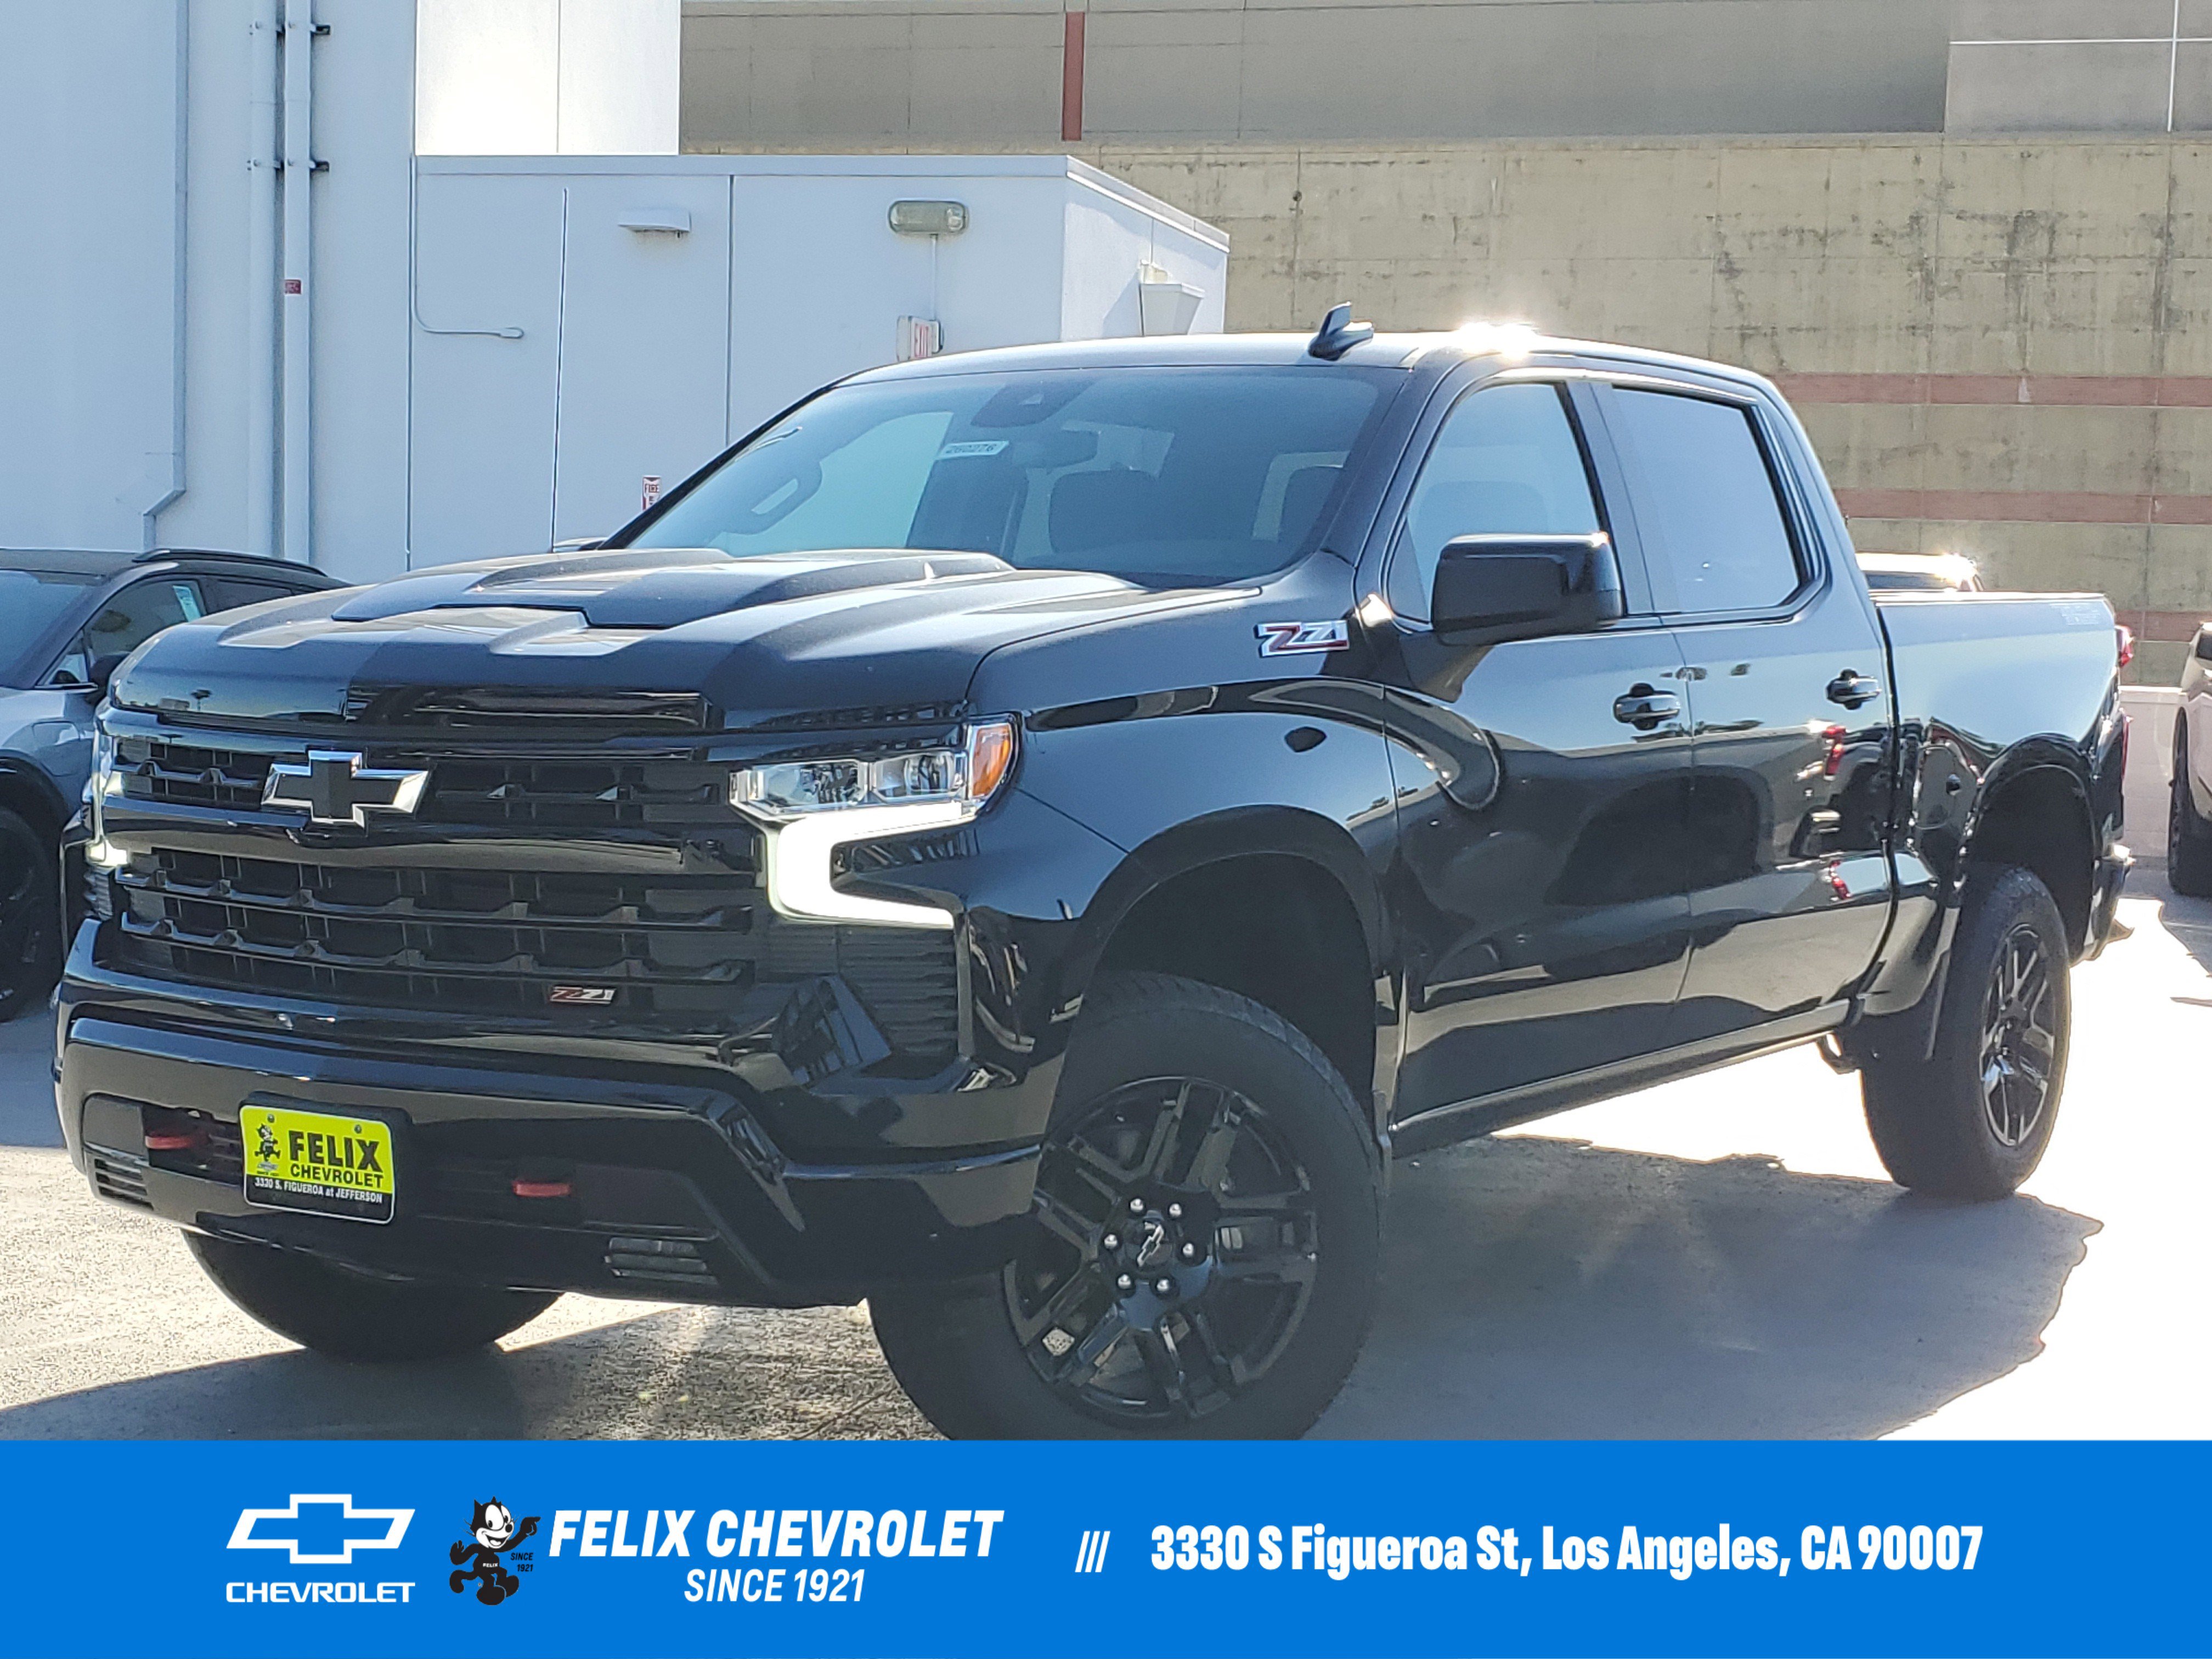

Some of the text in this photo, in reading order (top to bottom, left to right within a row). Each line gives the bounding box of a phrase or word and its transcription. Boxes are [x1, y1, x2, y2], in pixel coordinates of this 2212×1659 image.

[1257, 620, 1350, 657] Z71
[550, 986, 617, 1005] Z71
[289, 1130, 383, 1173] FELIX
[291, 1164, 383, 1188] CHEVROLET
[284, 1181, 324, 1195] FIGUEROA
[325, 1187, 334, 1198] at
[335, 1189, 383, 1204] JEFFERSON
